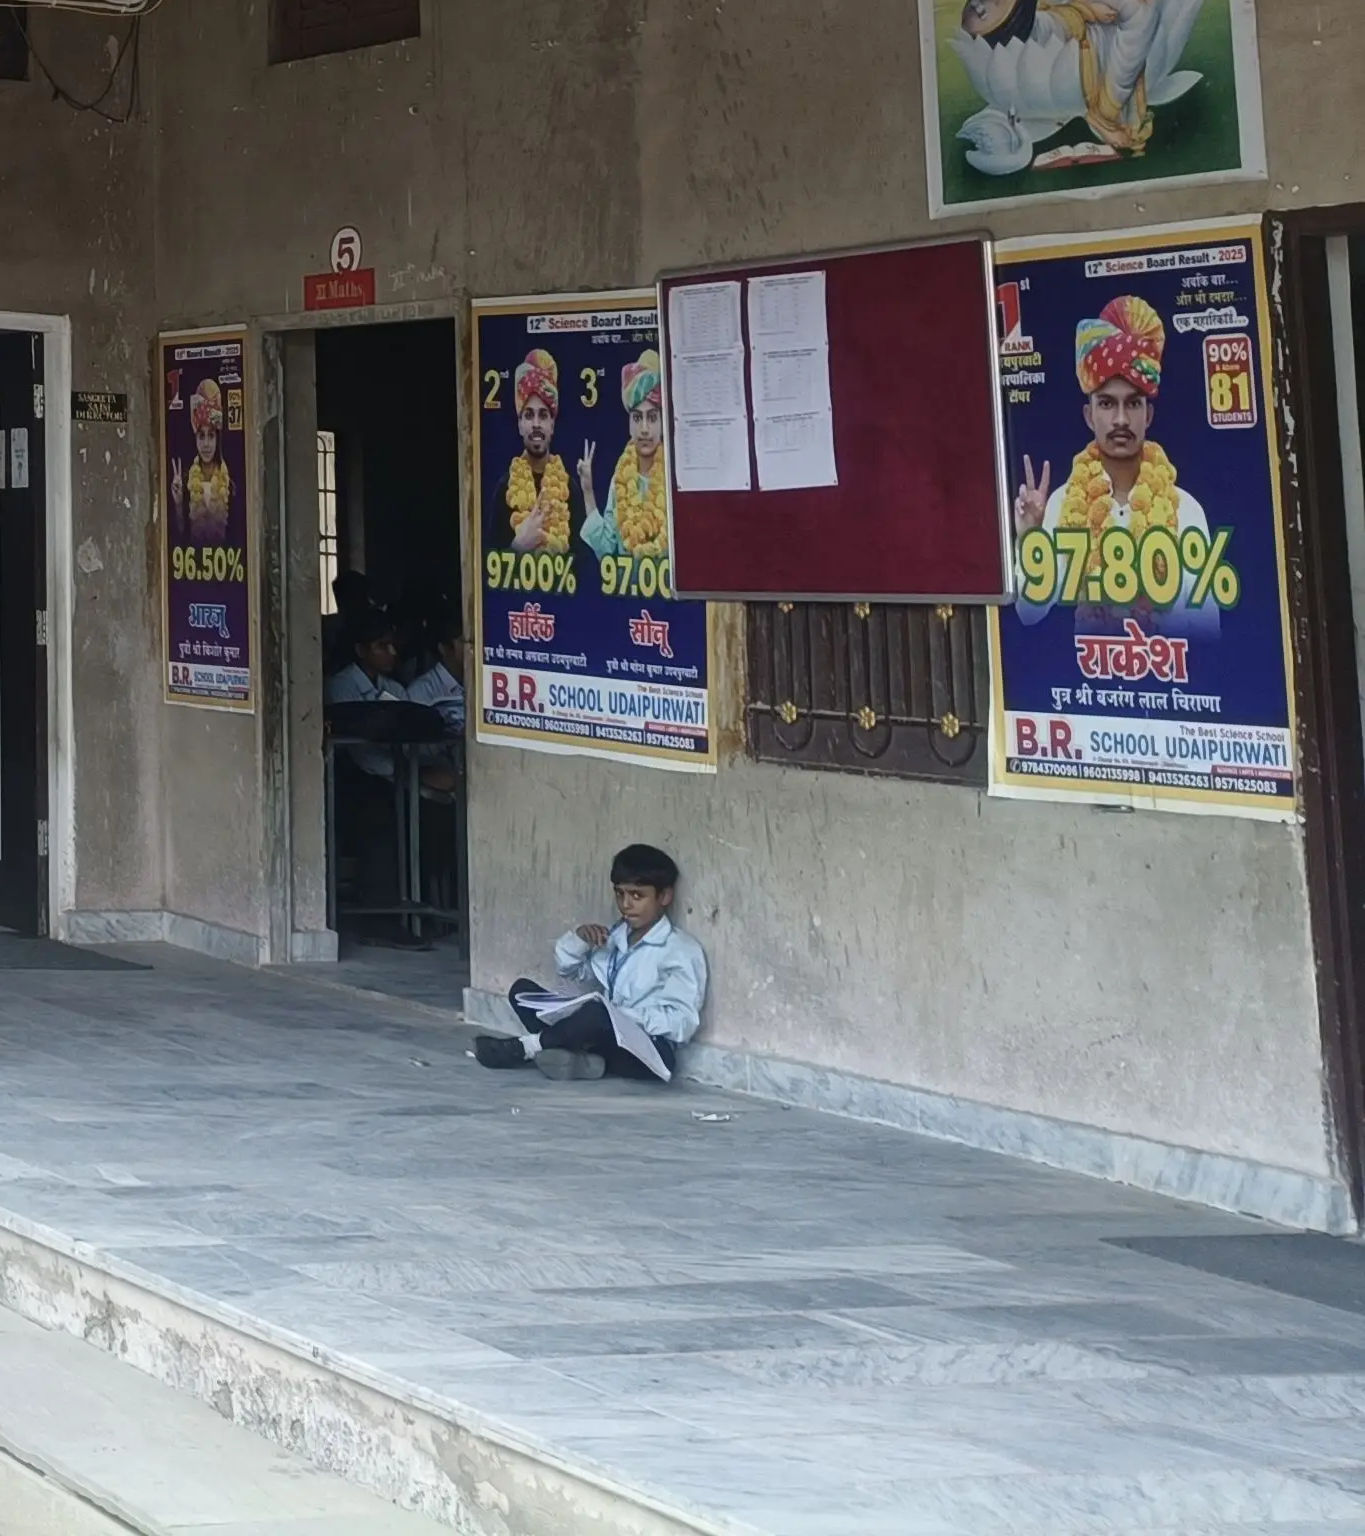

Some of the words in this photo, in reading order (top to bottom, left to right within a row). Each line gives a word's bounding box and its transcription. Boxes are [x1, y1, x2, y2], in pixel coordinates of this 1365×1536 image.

[337, 237, 355, 272] 5
[173, 546, 244, 582] 96.50%
[486, 551, 576, 594] 97.00%
[1020, 526, 1240, 608] 97.80%
[508, 603, 554, 643] हार्दिक
[629, 609, 674, 658] सोनू
[1075, 618, 1188, 683] राकेश
[1052, 687, 1071, 710] पुत्र
[1075, 686, 1092, 706] श्री
[1096, 686, 1134, 708] बजरंग
[1139, 692, 1168, 712] लाल
[1173, 691, 1221, 712] चिराणा
[1016, 717, 1083, 760] B.R.
[1090, 730, 1159, 757] SCHOOL
[1165, 736, 1287, 766] UDAIPURWATI
